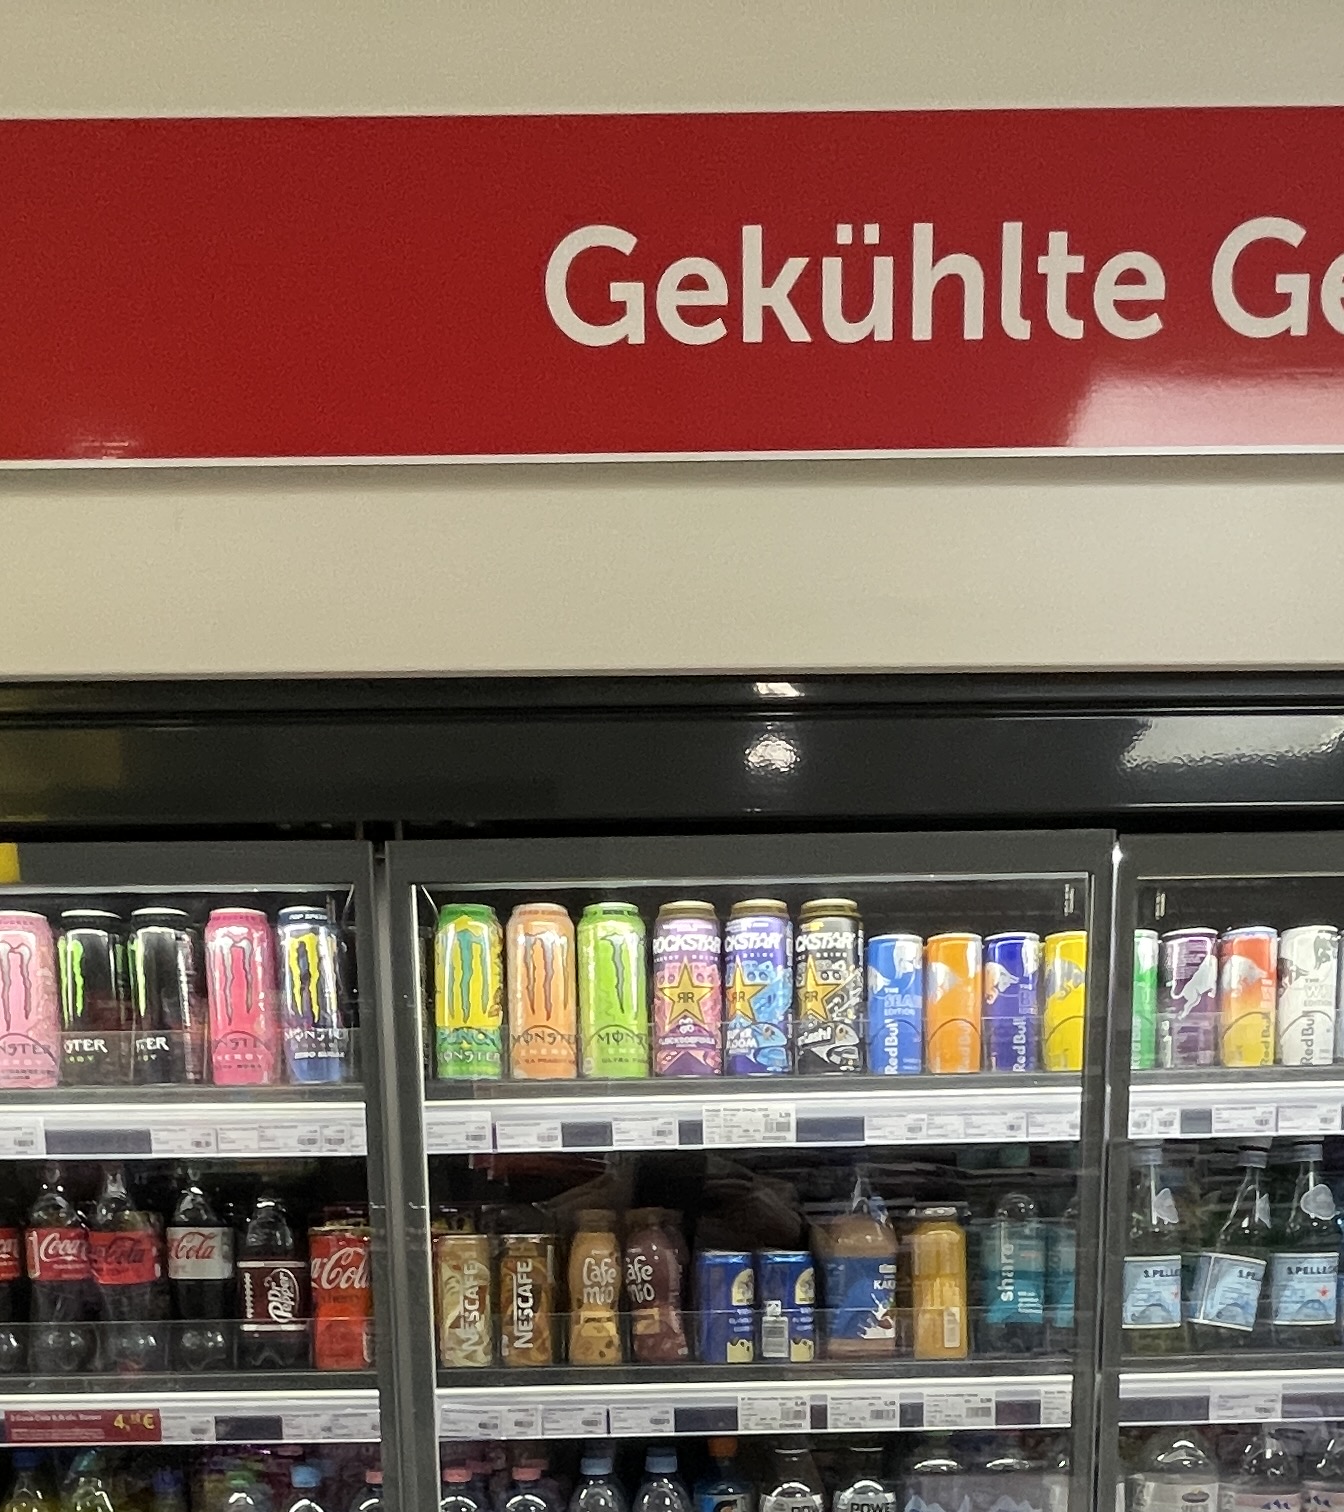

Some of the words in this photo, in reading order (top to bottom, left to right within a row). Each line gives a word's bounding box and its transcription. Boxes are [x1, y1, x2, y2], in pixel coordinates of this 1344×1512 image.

[545, 222, 1164, 346] Gekühlte
[884, 1018, 899, 1049] Bull
[884, 1049, 898, 1075] Red
[1300, 1037, 1314, 1066] Red
[997, 1243, 1014, 1302] share
